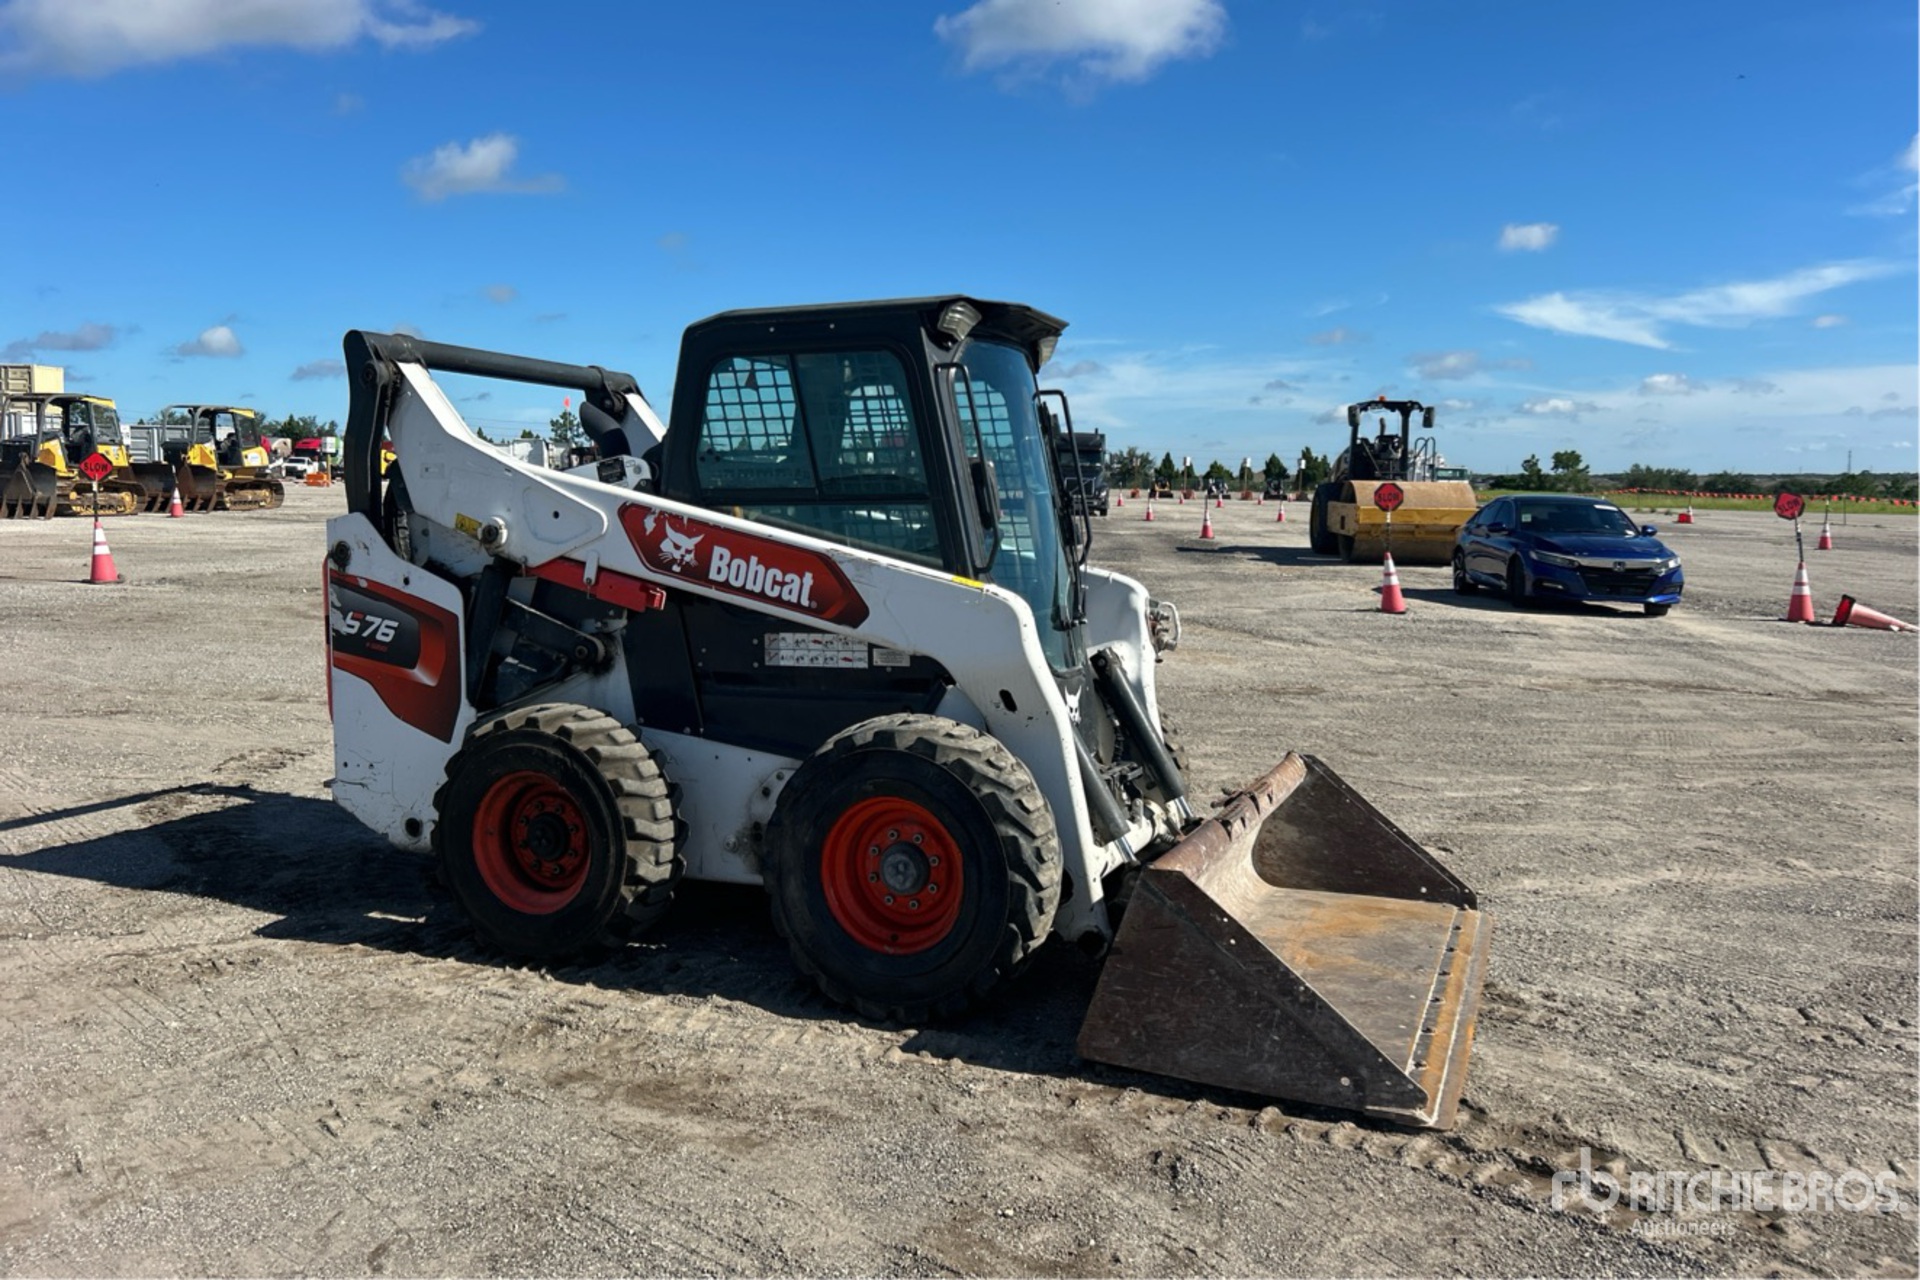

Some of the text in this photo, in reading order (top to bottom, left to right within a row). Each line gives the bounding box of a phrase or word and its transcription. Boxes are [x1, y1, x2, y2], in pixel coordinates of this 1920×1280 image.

[83, 461, 109, 472] SLOW
[709, 545, 813, 607] Bobcat
[342, 611, 400, 642] S76
